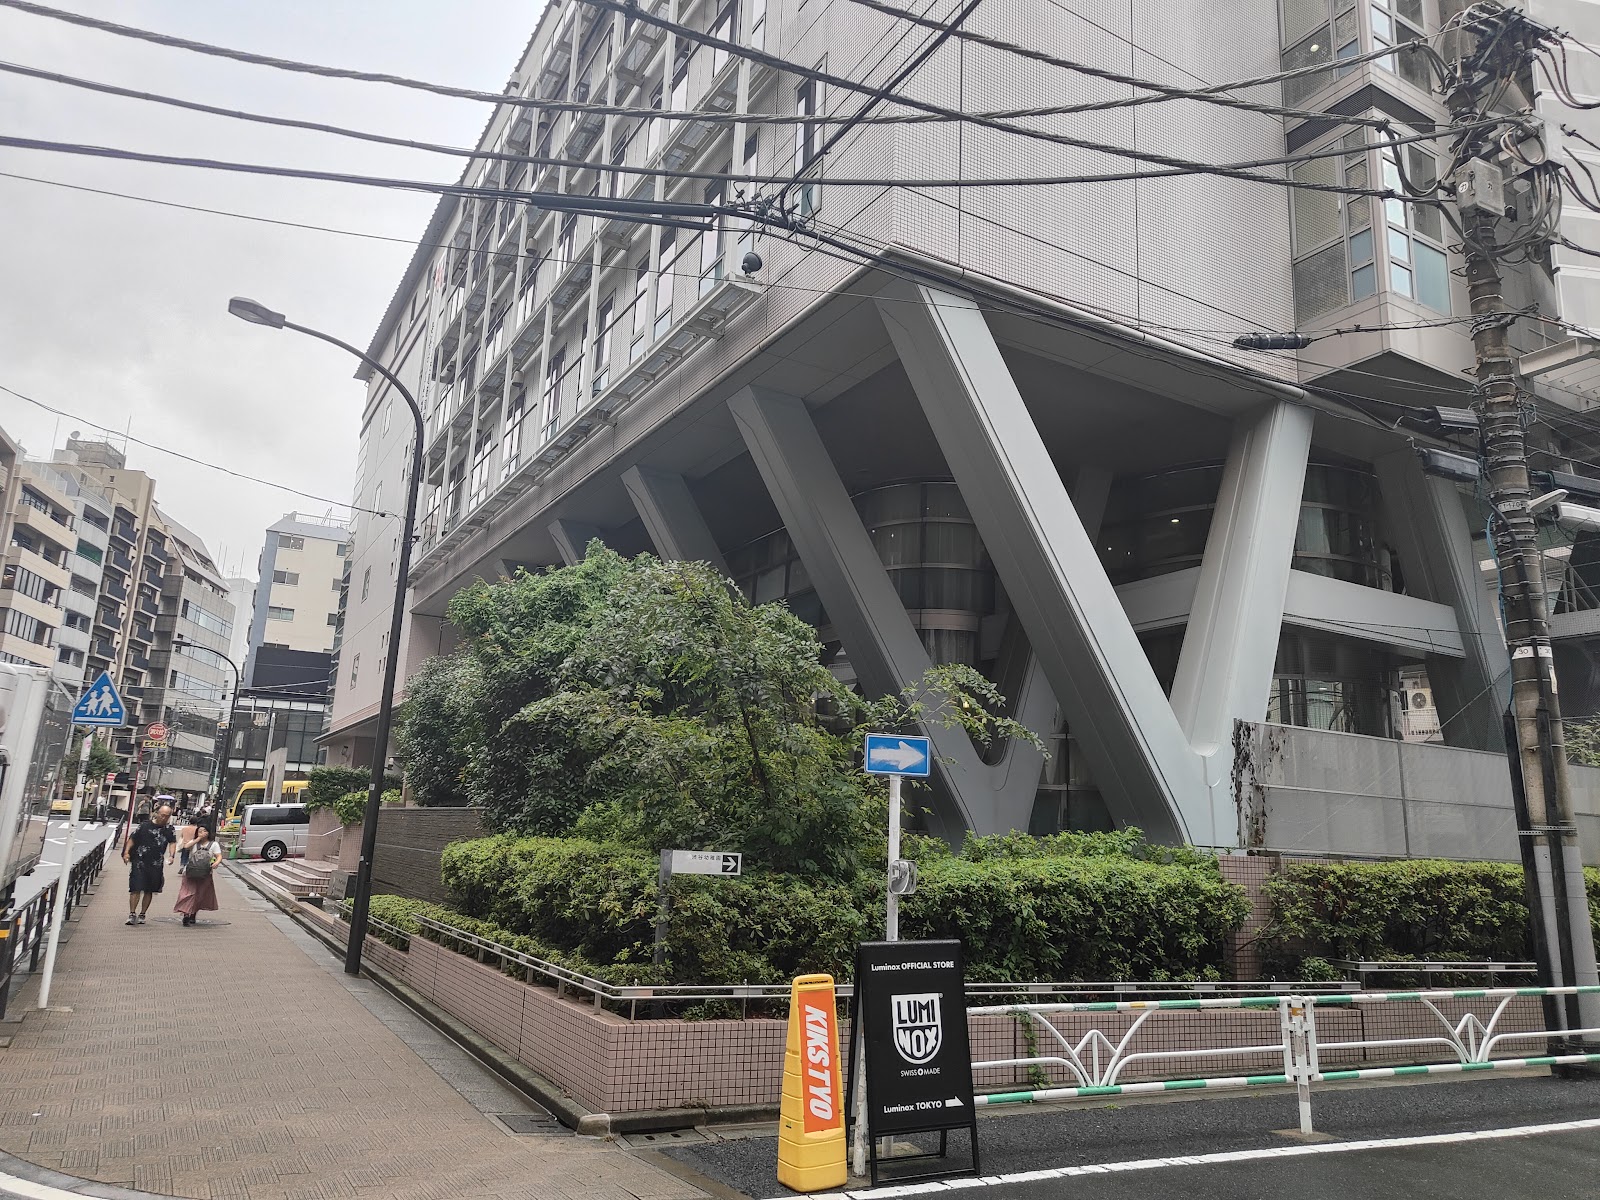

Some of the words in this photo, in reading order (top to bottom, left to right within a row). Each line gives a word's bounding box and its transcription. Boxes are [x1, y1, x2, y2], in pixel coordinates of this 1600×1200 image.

[871, 963, 900, 971] Luminox
[901, 962, 932, 970] OFFICIAL
[932, 961, 954, 969] STORE
[897, 999, 936, 1024] LUMI
[897, 1026, 938, 1058] NOX
[900, 1069, 918, 1077] SWISS
[924, 1067, 941, 1075] MADE
[883, 1103, 915, 1114] Luminox
[915, 1100, 942, 1110] TOKYO
